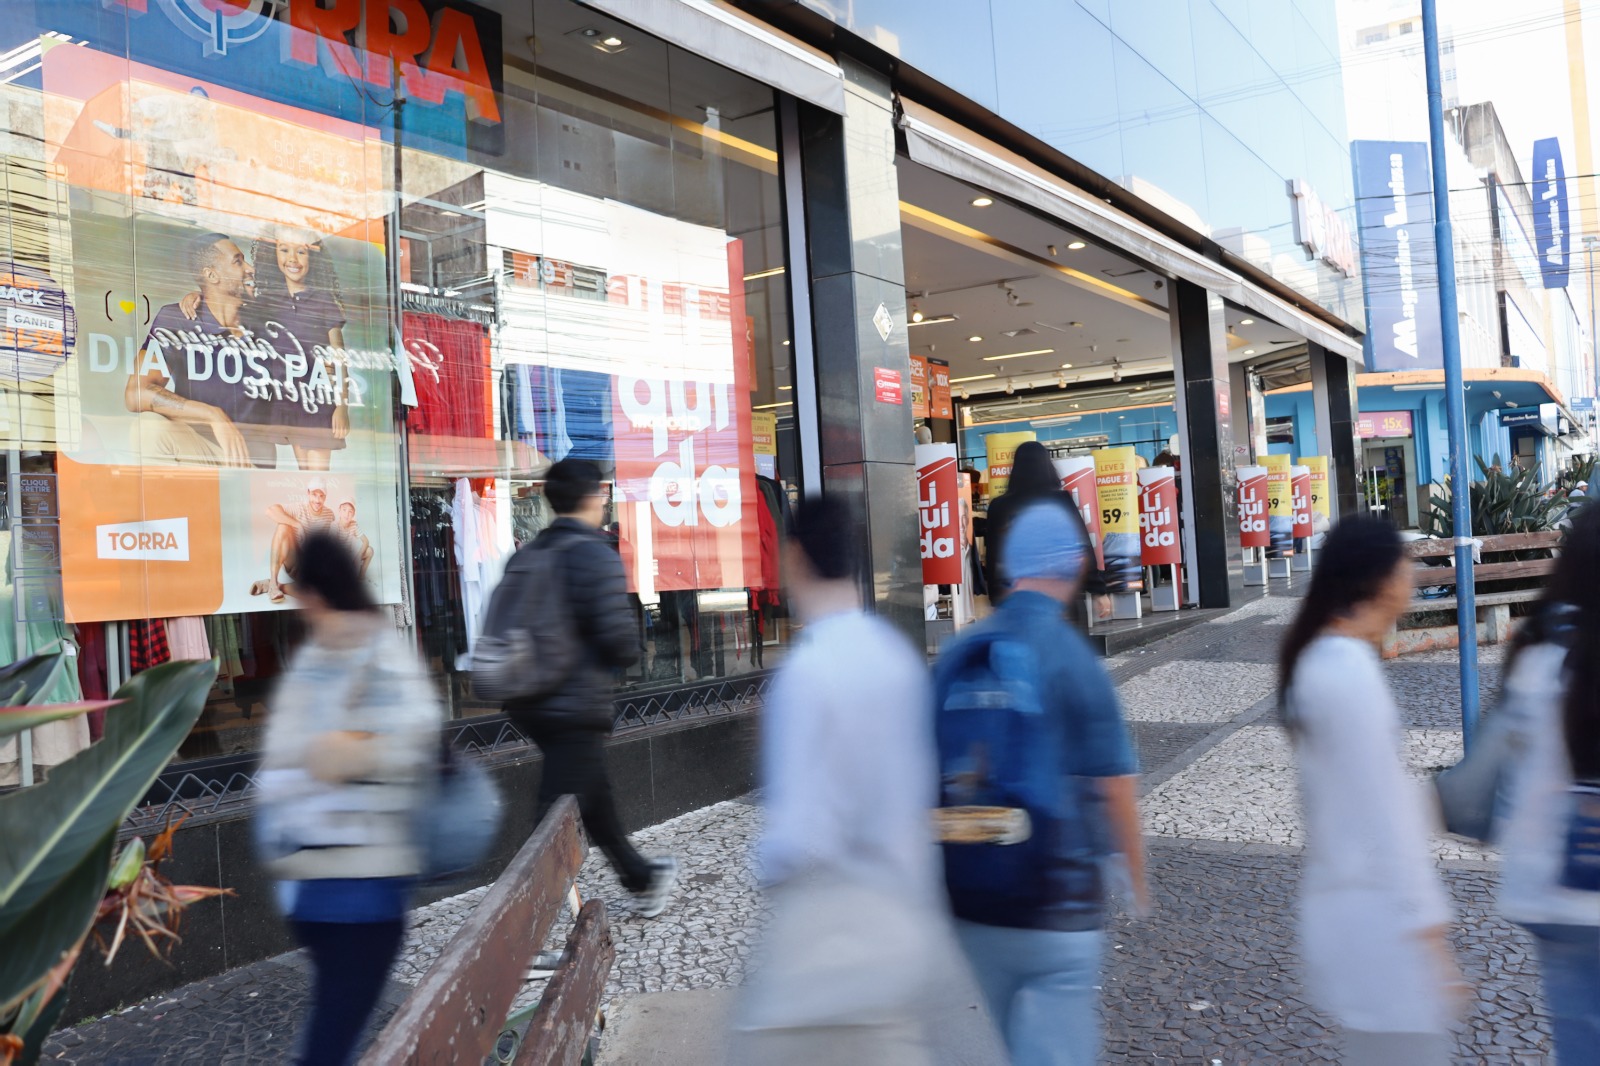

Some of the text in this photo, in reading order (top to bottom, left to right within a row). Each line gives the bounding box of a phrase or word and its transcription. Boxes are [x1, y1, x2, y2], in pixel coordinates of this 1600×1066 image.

[14, 313, 55, 329] GANHE
[88, 332, 171, 378] DIA
[1100, 462, 1125, 472] LEVE 3
[650, 435, 742, 528] da
[1097, 475, 1129, 485] PAGUE 2
[1142, 492, 1161, 513] Li
[1240, 487, 1256, 503] Li
[1139, 506, 1171, 533] qui
[1240, 515, 1266, 533] da
[108, 531, 179, 551] TORRA
[1144, 526, 1175, 548] da
